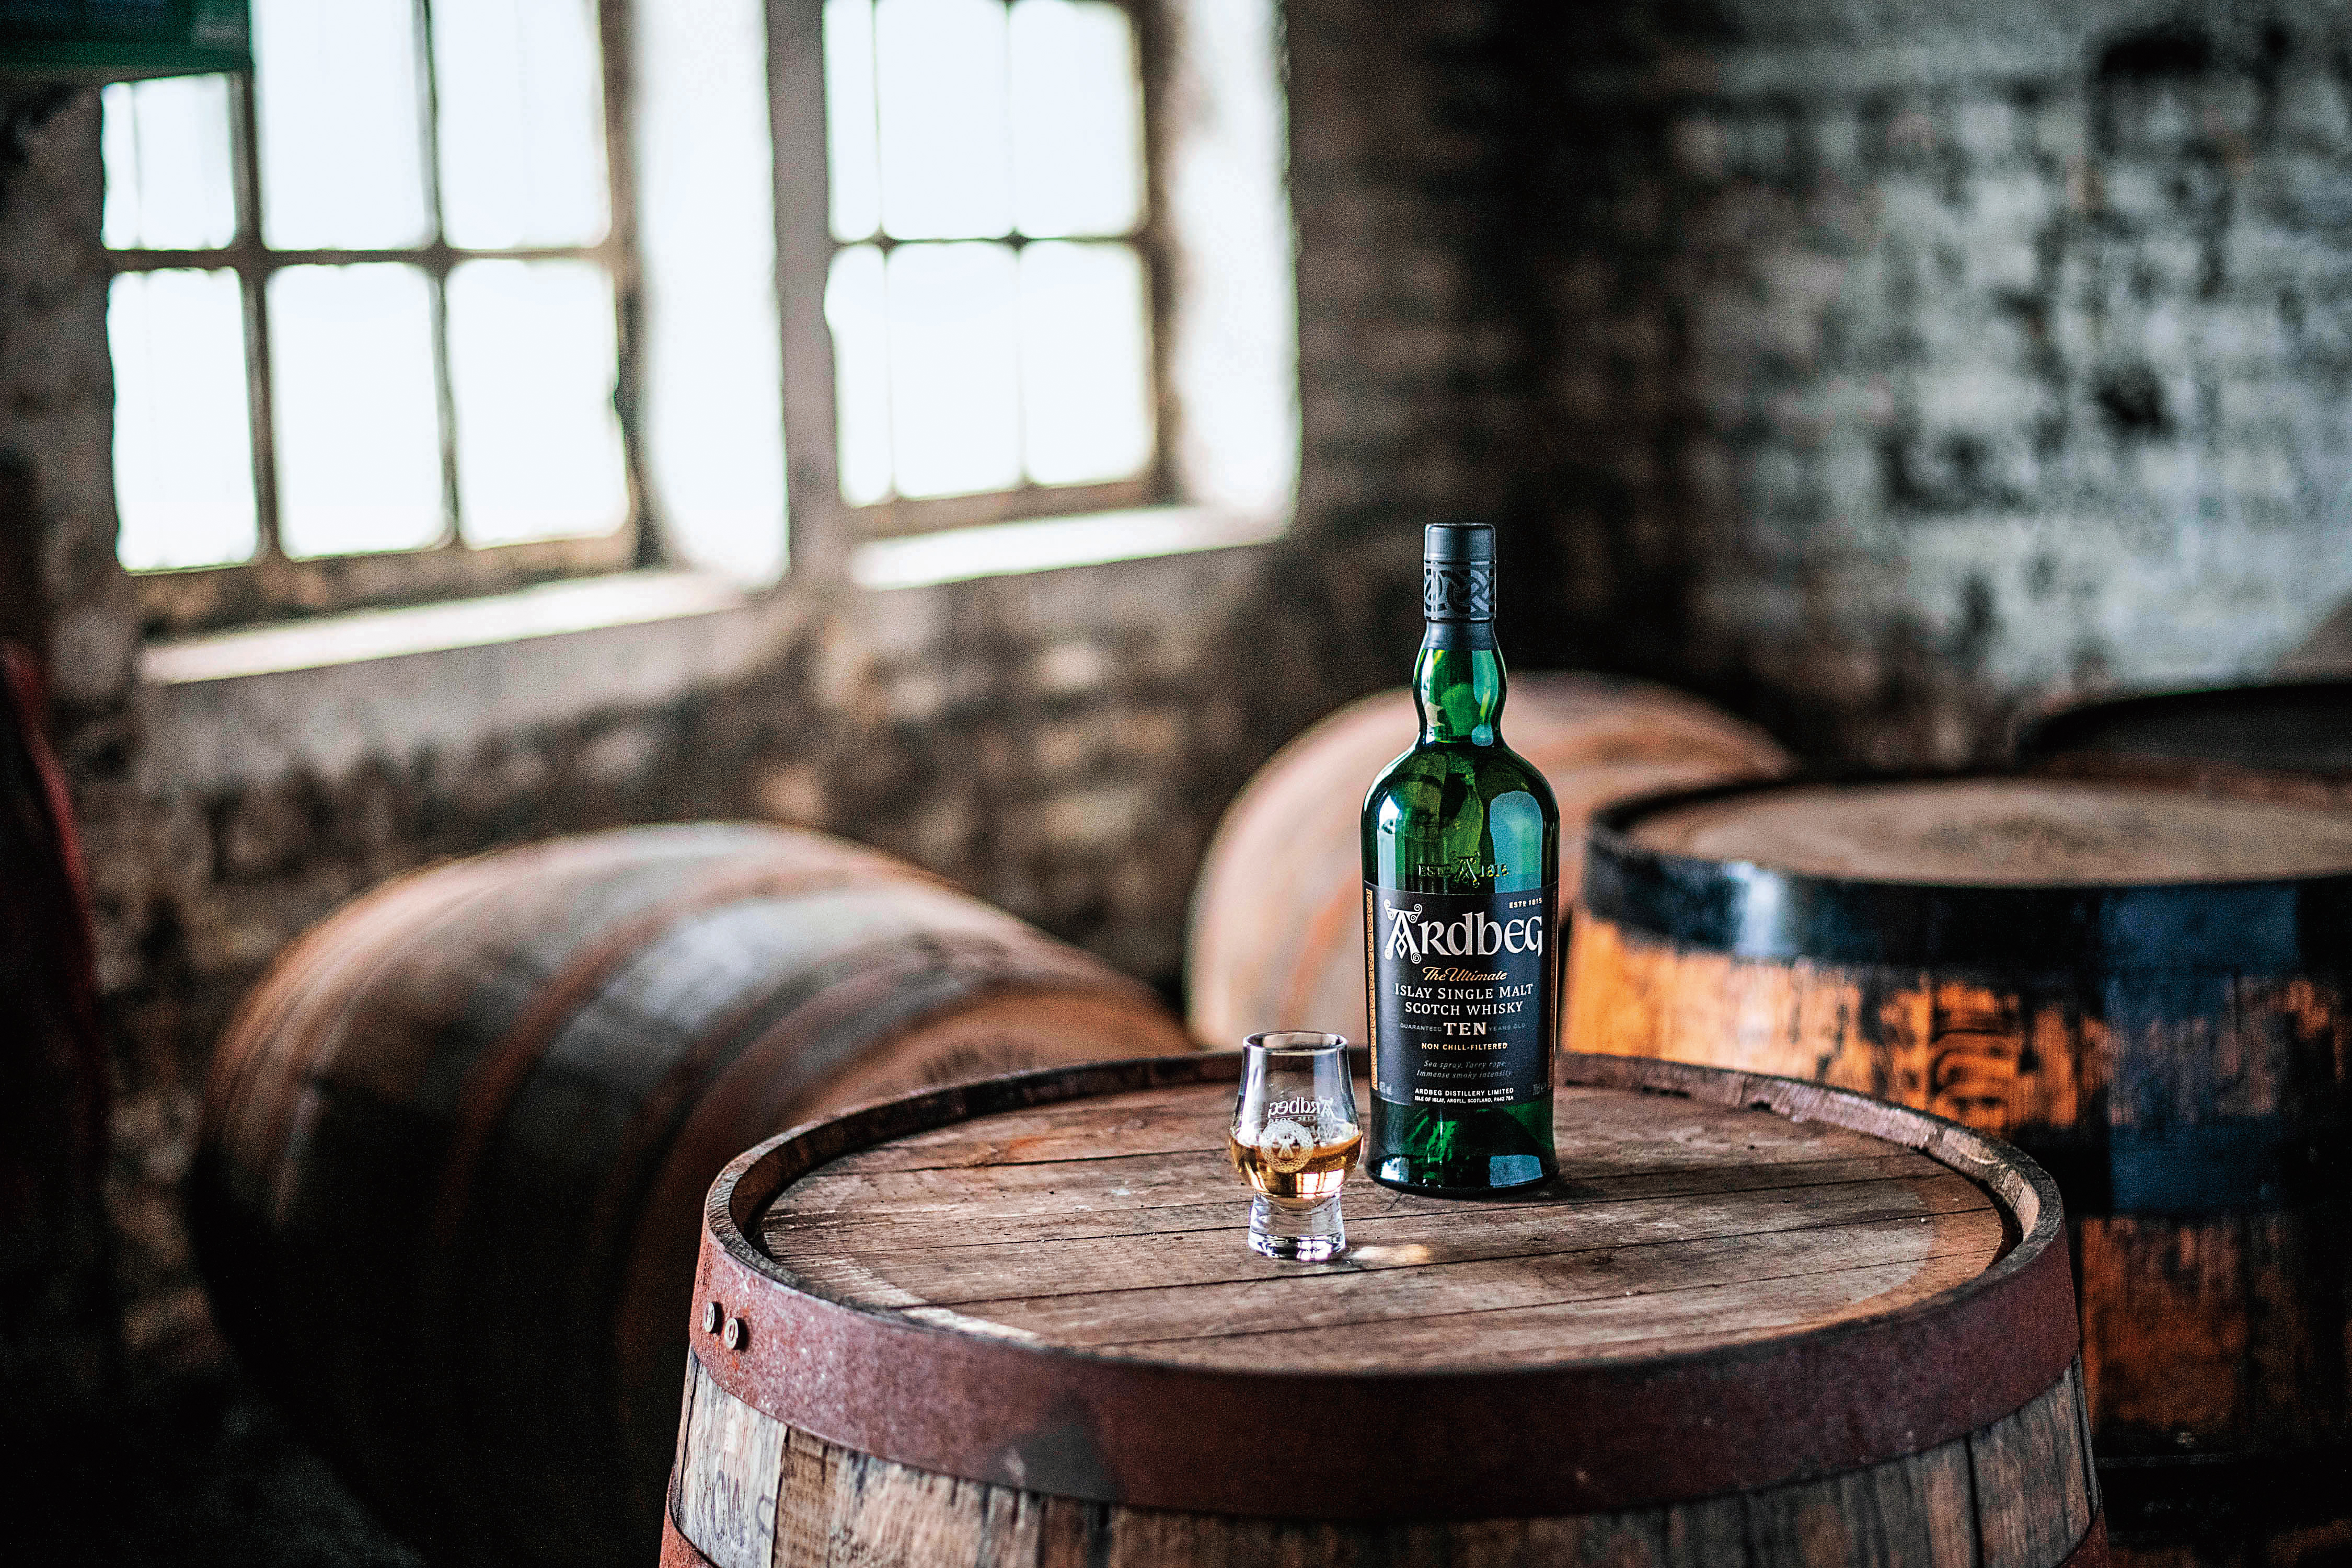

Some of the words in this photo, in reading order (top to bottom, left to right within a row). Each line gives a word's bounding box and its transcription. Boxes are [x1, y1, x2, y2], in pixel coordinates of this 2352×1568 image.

[1528, 897, 1542, 906] 1815
[1422, 966, 1446, 981] The
[1445, 967, 1508, 982] Ultimate
[1498, 983, 1534, 998] MALT
[1405, 1001, 1460, 1016] SCOTCH
[1466, 1001, 1524, 1016] WHISKY
[1400, 1023, 1442, 1032] GUARANTEED
[1443, 1022, 1487, 1035] TEN
[1442, 1042, 1508, 1050] CHILL-FILTERED
[1466, 1061, 1487, 1070] Tarry
[1416, 1069, 1450, 1078] Immense
[1452, 1071, 1478, 1079] smoky
[1488, 1087, 1514, 1096] LIMITED
